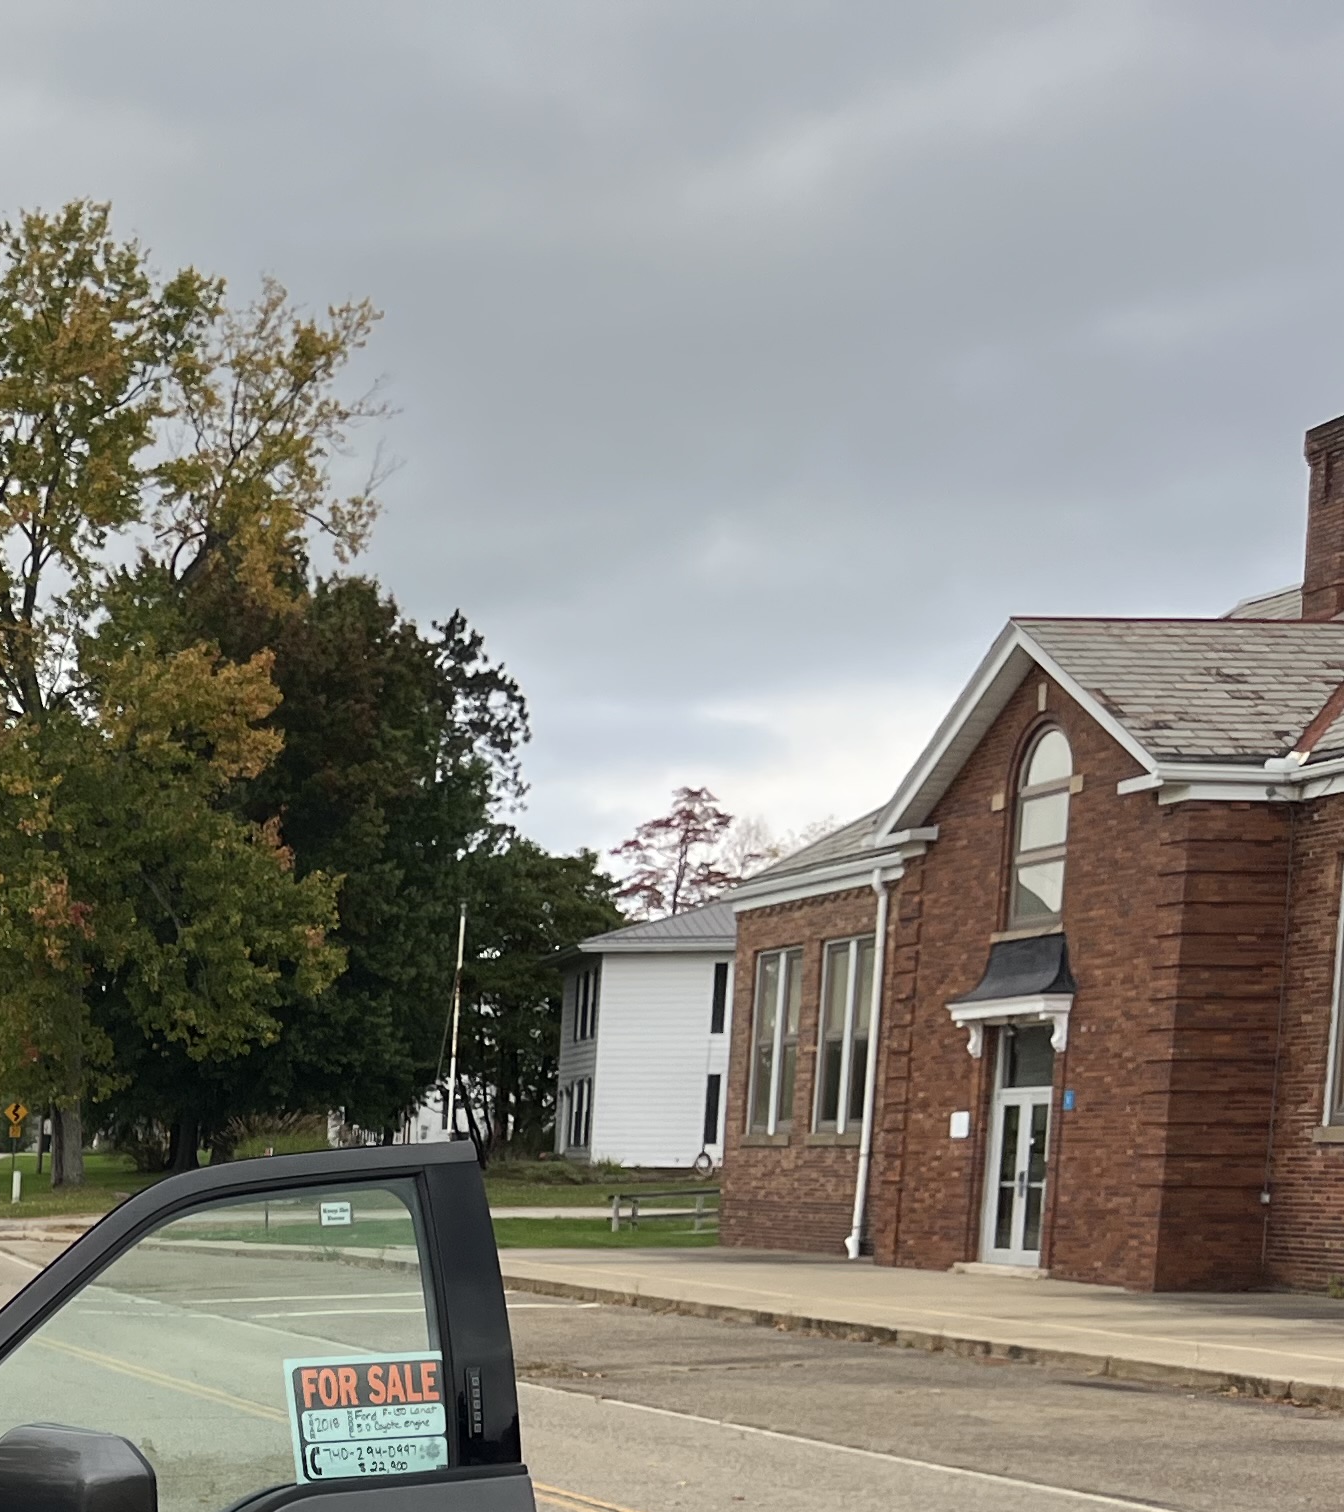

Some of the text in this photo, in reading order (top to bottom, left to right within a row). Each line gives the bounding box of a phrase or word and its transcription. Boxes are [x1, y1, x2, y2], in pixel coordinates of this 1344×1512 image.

[301, 1362, 440, 1408] FOR SALE
[355, 1408, 377, 1421] Ford
[314, 1417, 340, 1432] 2018
[404, 1418, 430, 1431] engine
